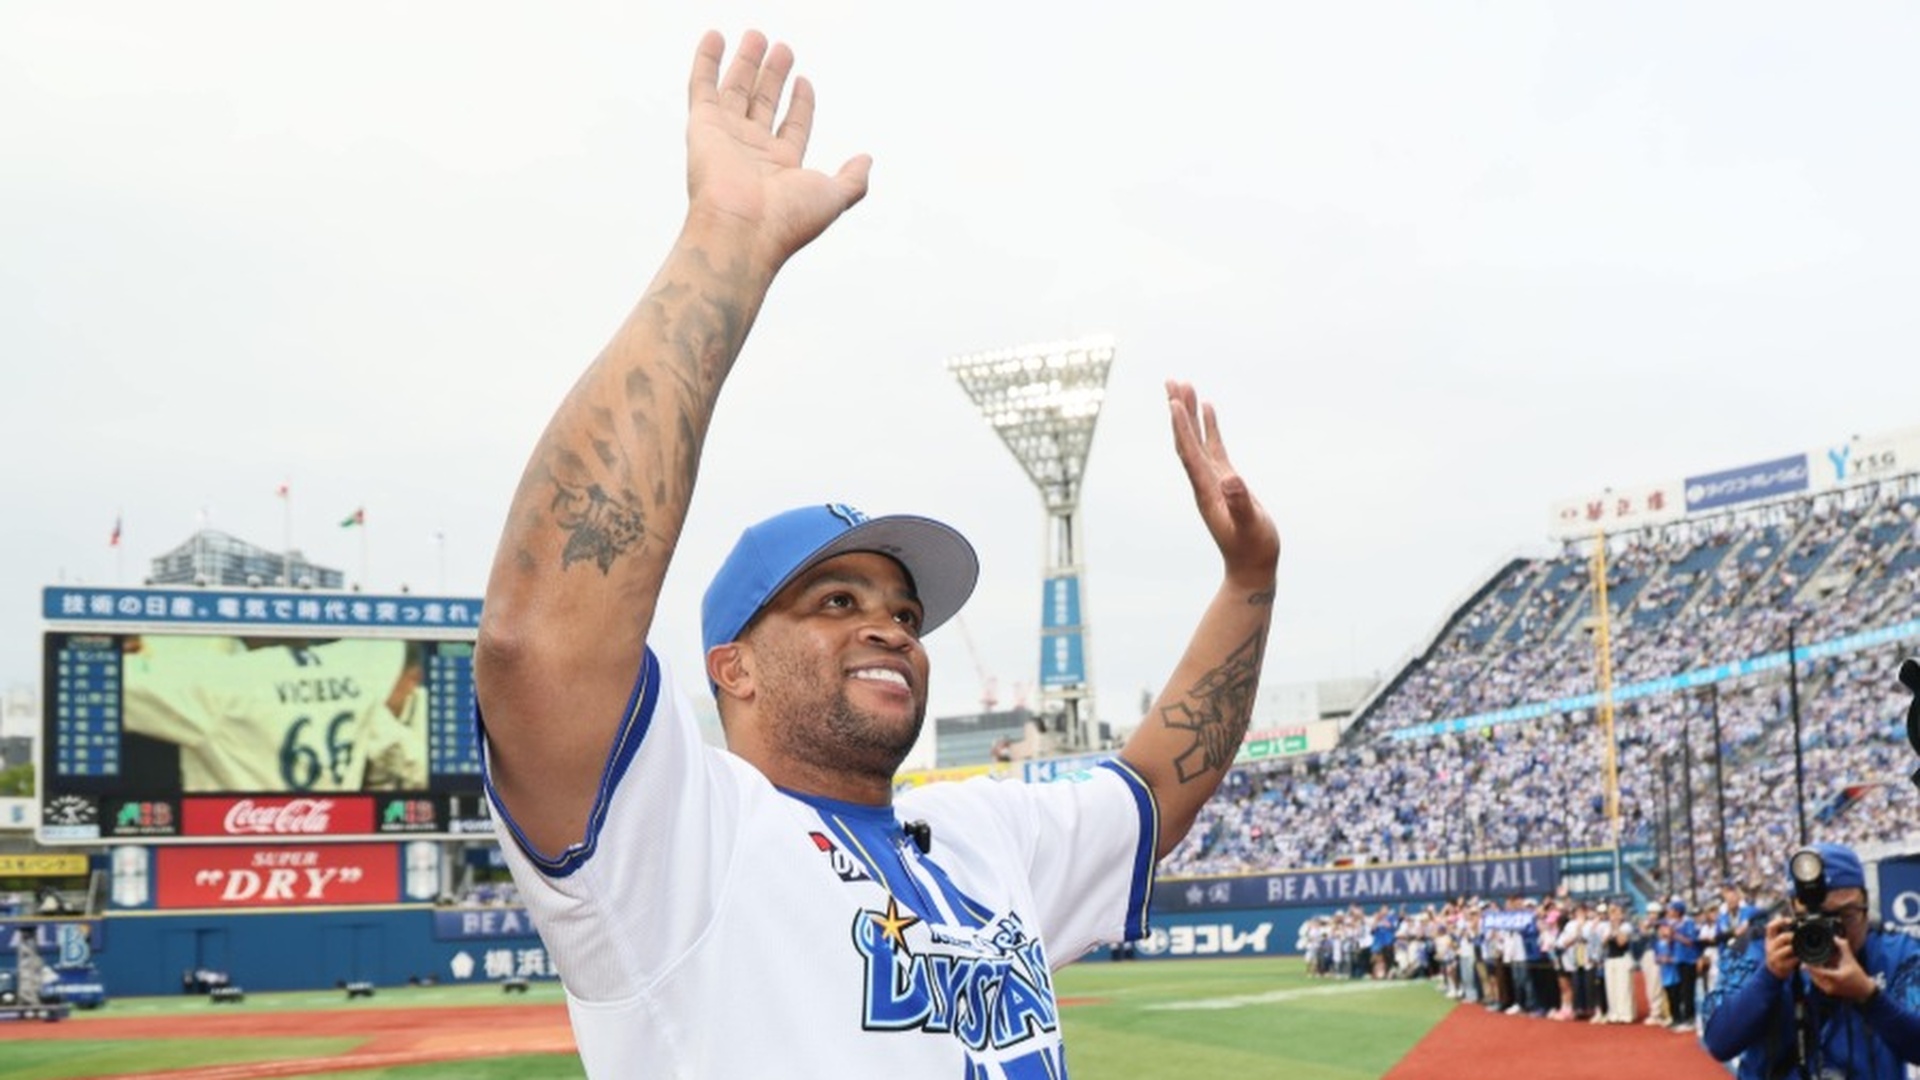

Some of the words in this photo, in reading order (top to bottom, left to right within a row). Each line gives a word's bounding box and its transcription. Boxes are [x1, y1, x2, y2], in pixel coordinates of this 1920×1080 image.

[252, 851, 319, 867] SUPER
[1267, 877, 1297, 901] BE
[1302, 876, 1320, 899] A
[1168, 922, 1274, 955] ヨコレイ
[484, 948, 558, 979] 横浜
